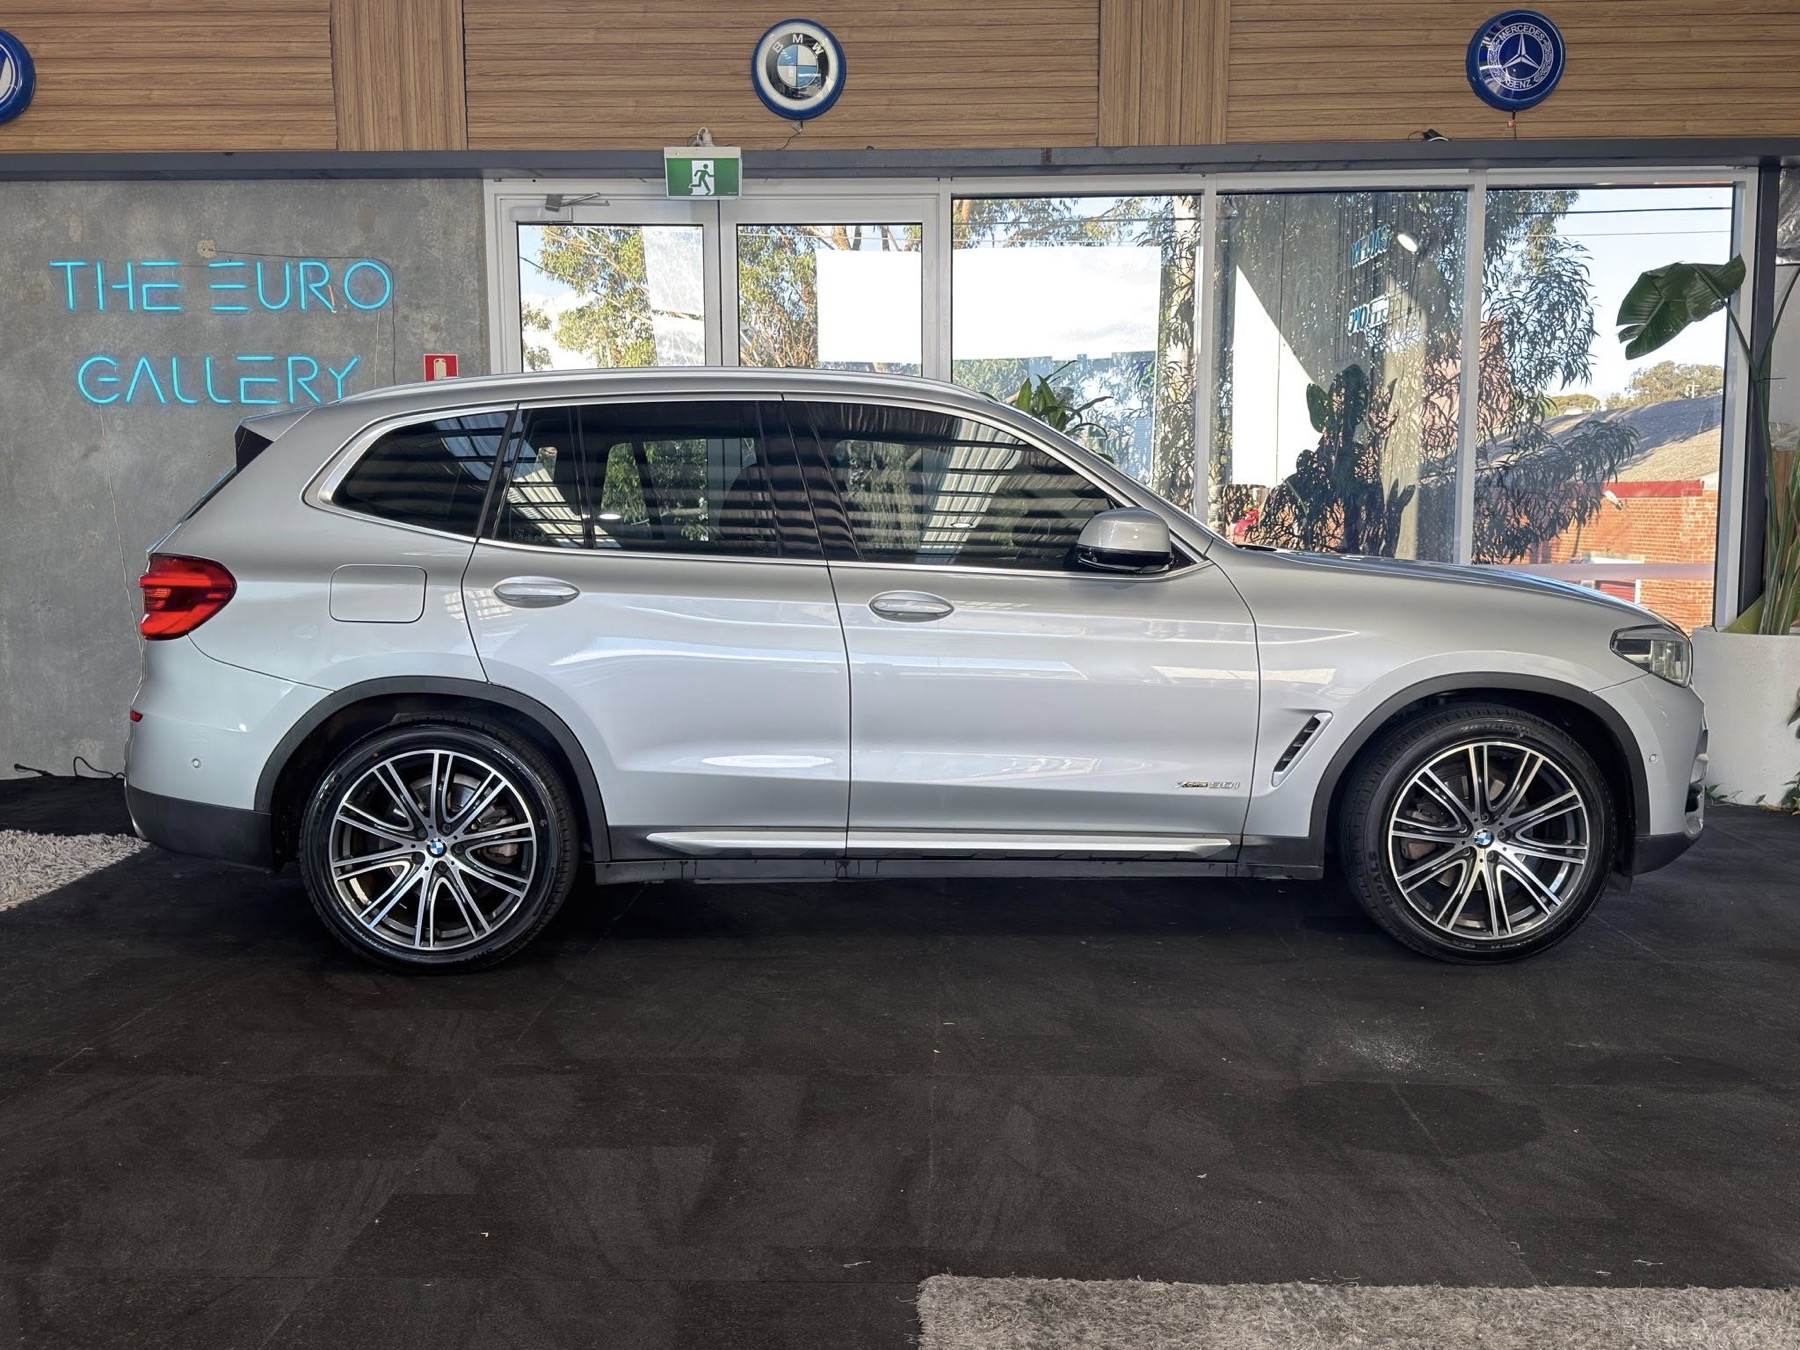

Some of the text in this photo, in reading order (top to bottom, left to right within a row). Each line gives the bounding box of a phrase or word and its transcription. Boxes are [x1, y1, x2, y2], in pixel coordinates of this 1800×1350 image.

[1500, 25, 1545, 41] MERCEDES
[773, 34, 824, 55] BMW
[1508, 79, 1532, 89] BENZ
[50, 260, 392, 312] THE EURO
[77, 354, 361, 405] GALLERY
